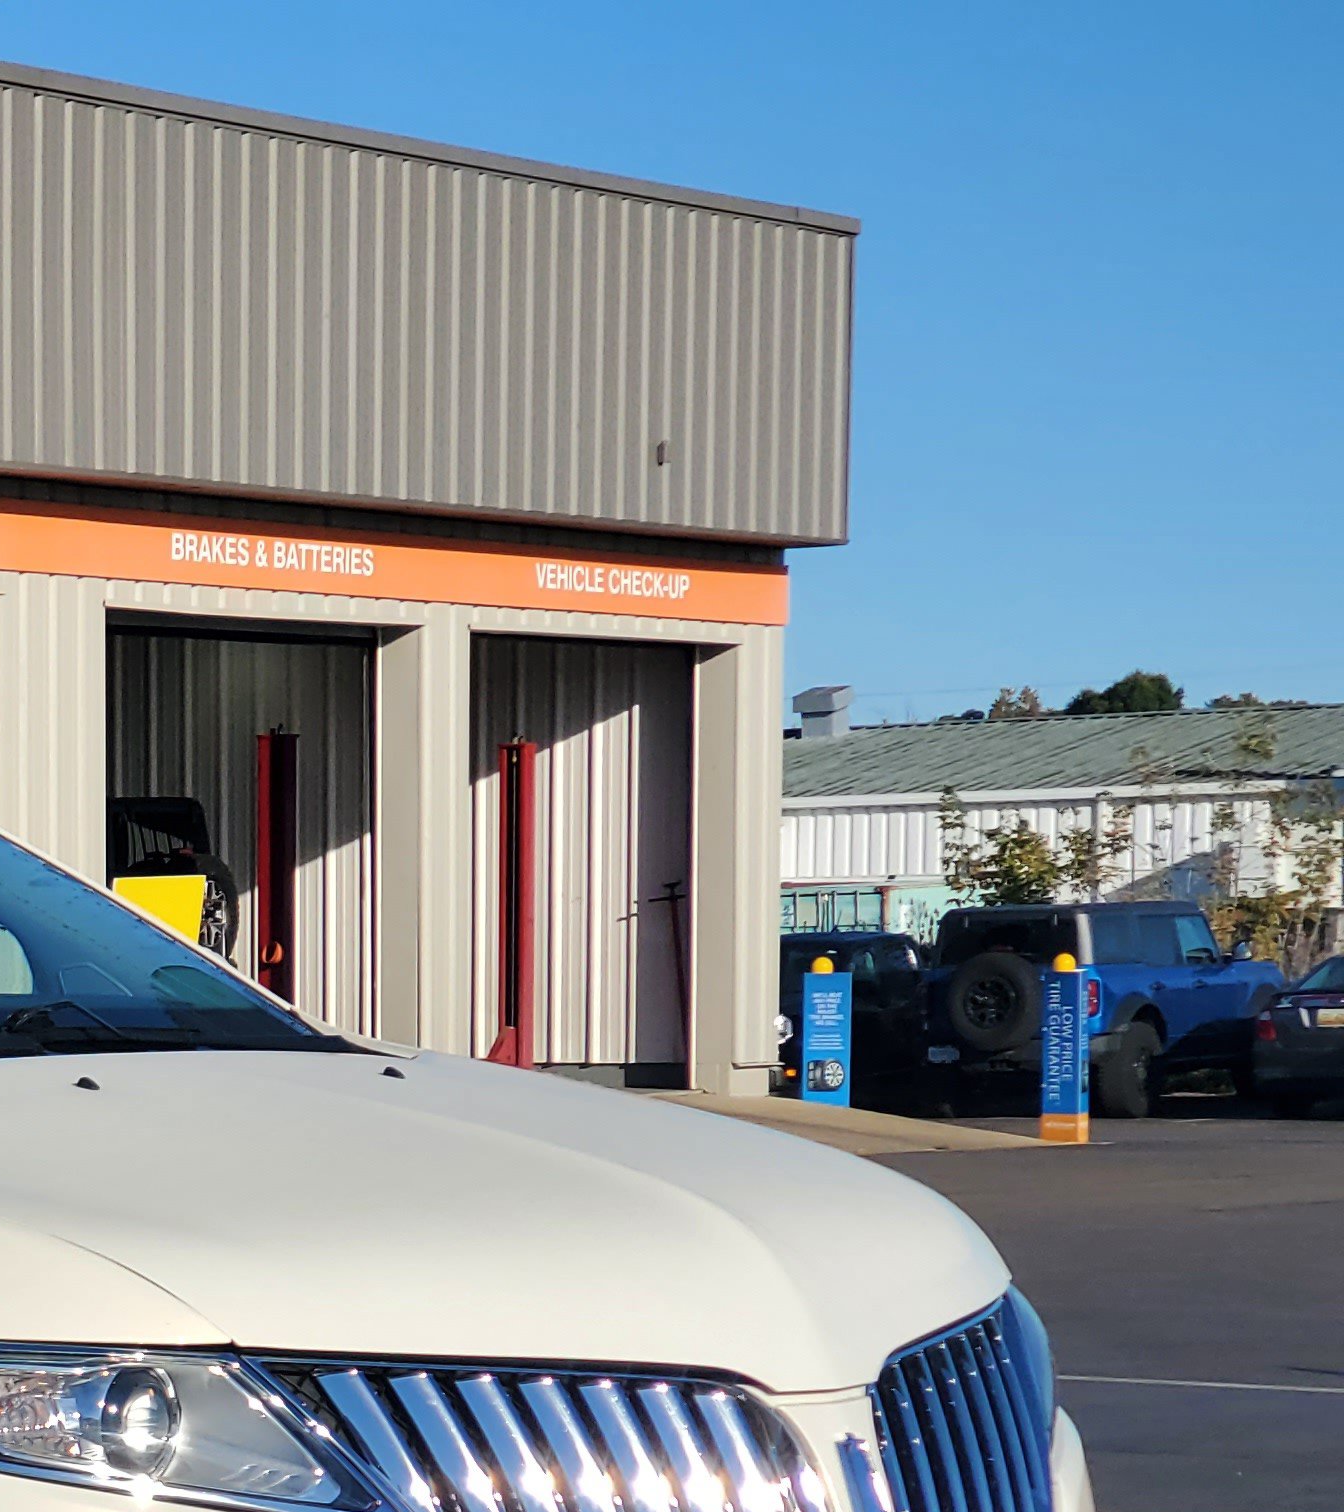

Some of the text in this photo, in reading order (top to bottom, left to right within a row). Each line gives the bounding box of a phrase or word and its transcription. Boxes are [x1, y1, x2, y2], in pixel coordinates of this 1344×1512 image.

[170, 532, 375, 577] BRAKES & BATTERIES
[535, 562, 690, 599] VEHICLE CHECK-UP
[1048, 981, 1061, 1012] TIRE
[1062, 1006, 1074, 1037] LOW
